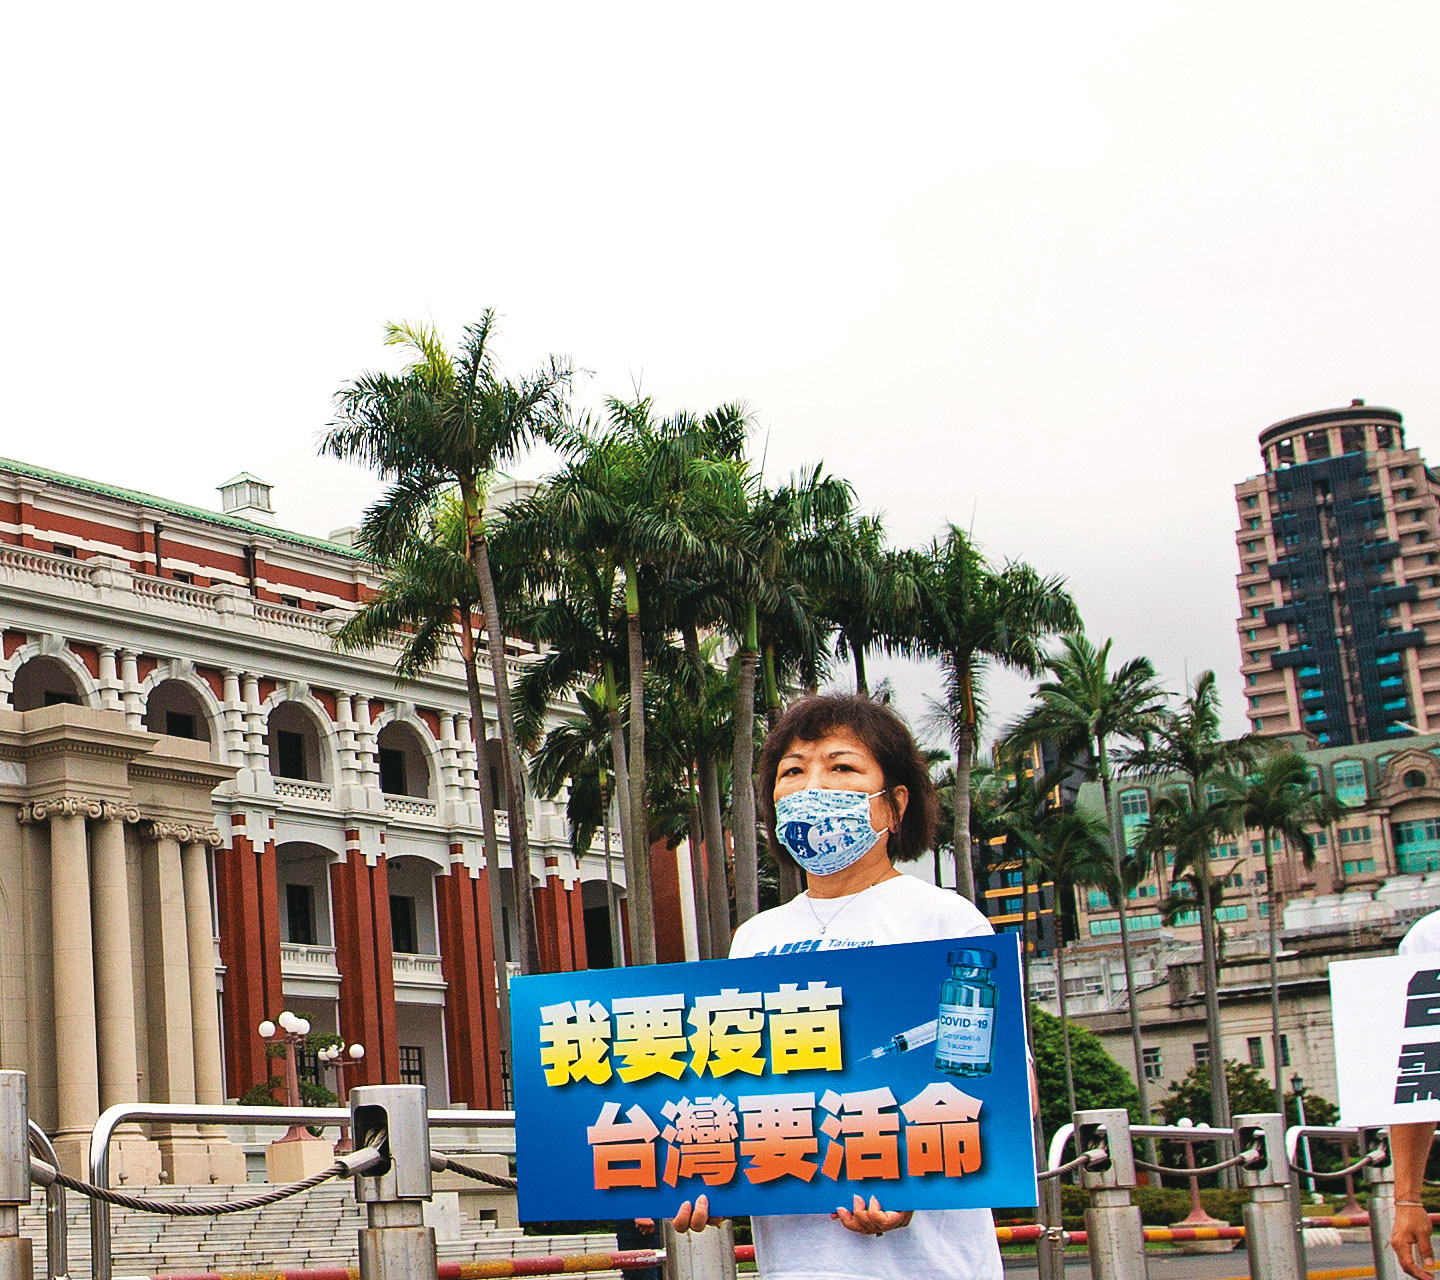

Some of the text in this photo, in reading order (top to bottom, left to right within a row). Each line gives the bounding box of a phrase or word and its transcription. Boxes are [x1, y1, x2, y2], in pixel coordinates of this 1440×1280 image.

[539, 981, 843, 1086] 我要疫苗
[940, 1015, 988, 1029] COVID-19
[587, 1082, 984, 1190] 台灣要活命
